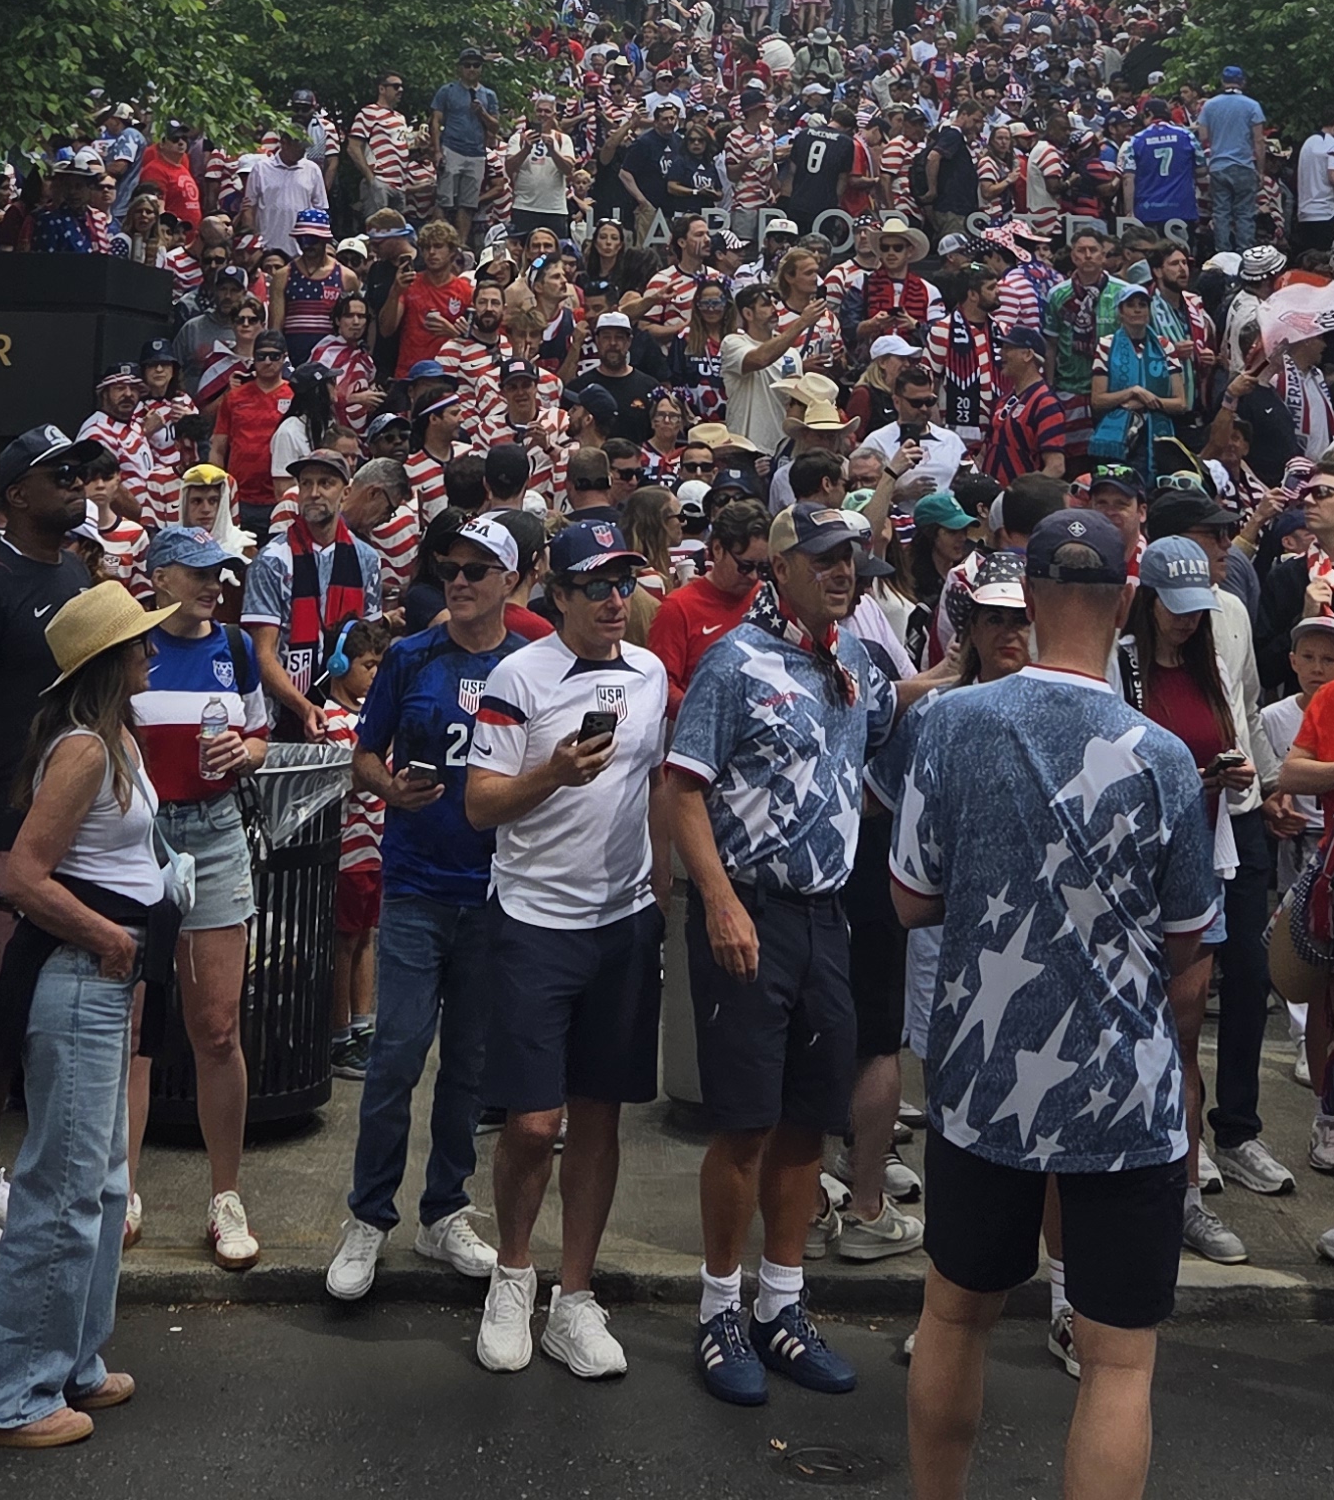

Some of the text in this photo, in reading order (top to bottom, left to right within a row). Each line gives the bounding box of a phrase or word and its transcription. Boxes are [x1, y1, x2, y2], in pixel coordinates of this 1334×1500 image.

[807, 140, 828, 174] 8
[1154, 147, 1173, 177] 7
[956, 396, 971, 409] 20
[956, 410, 970, 423] 23
[289, 652, 311, 673] SA
[599, 687, 623, 704] USA
